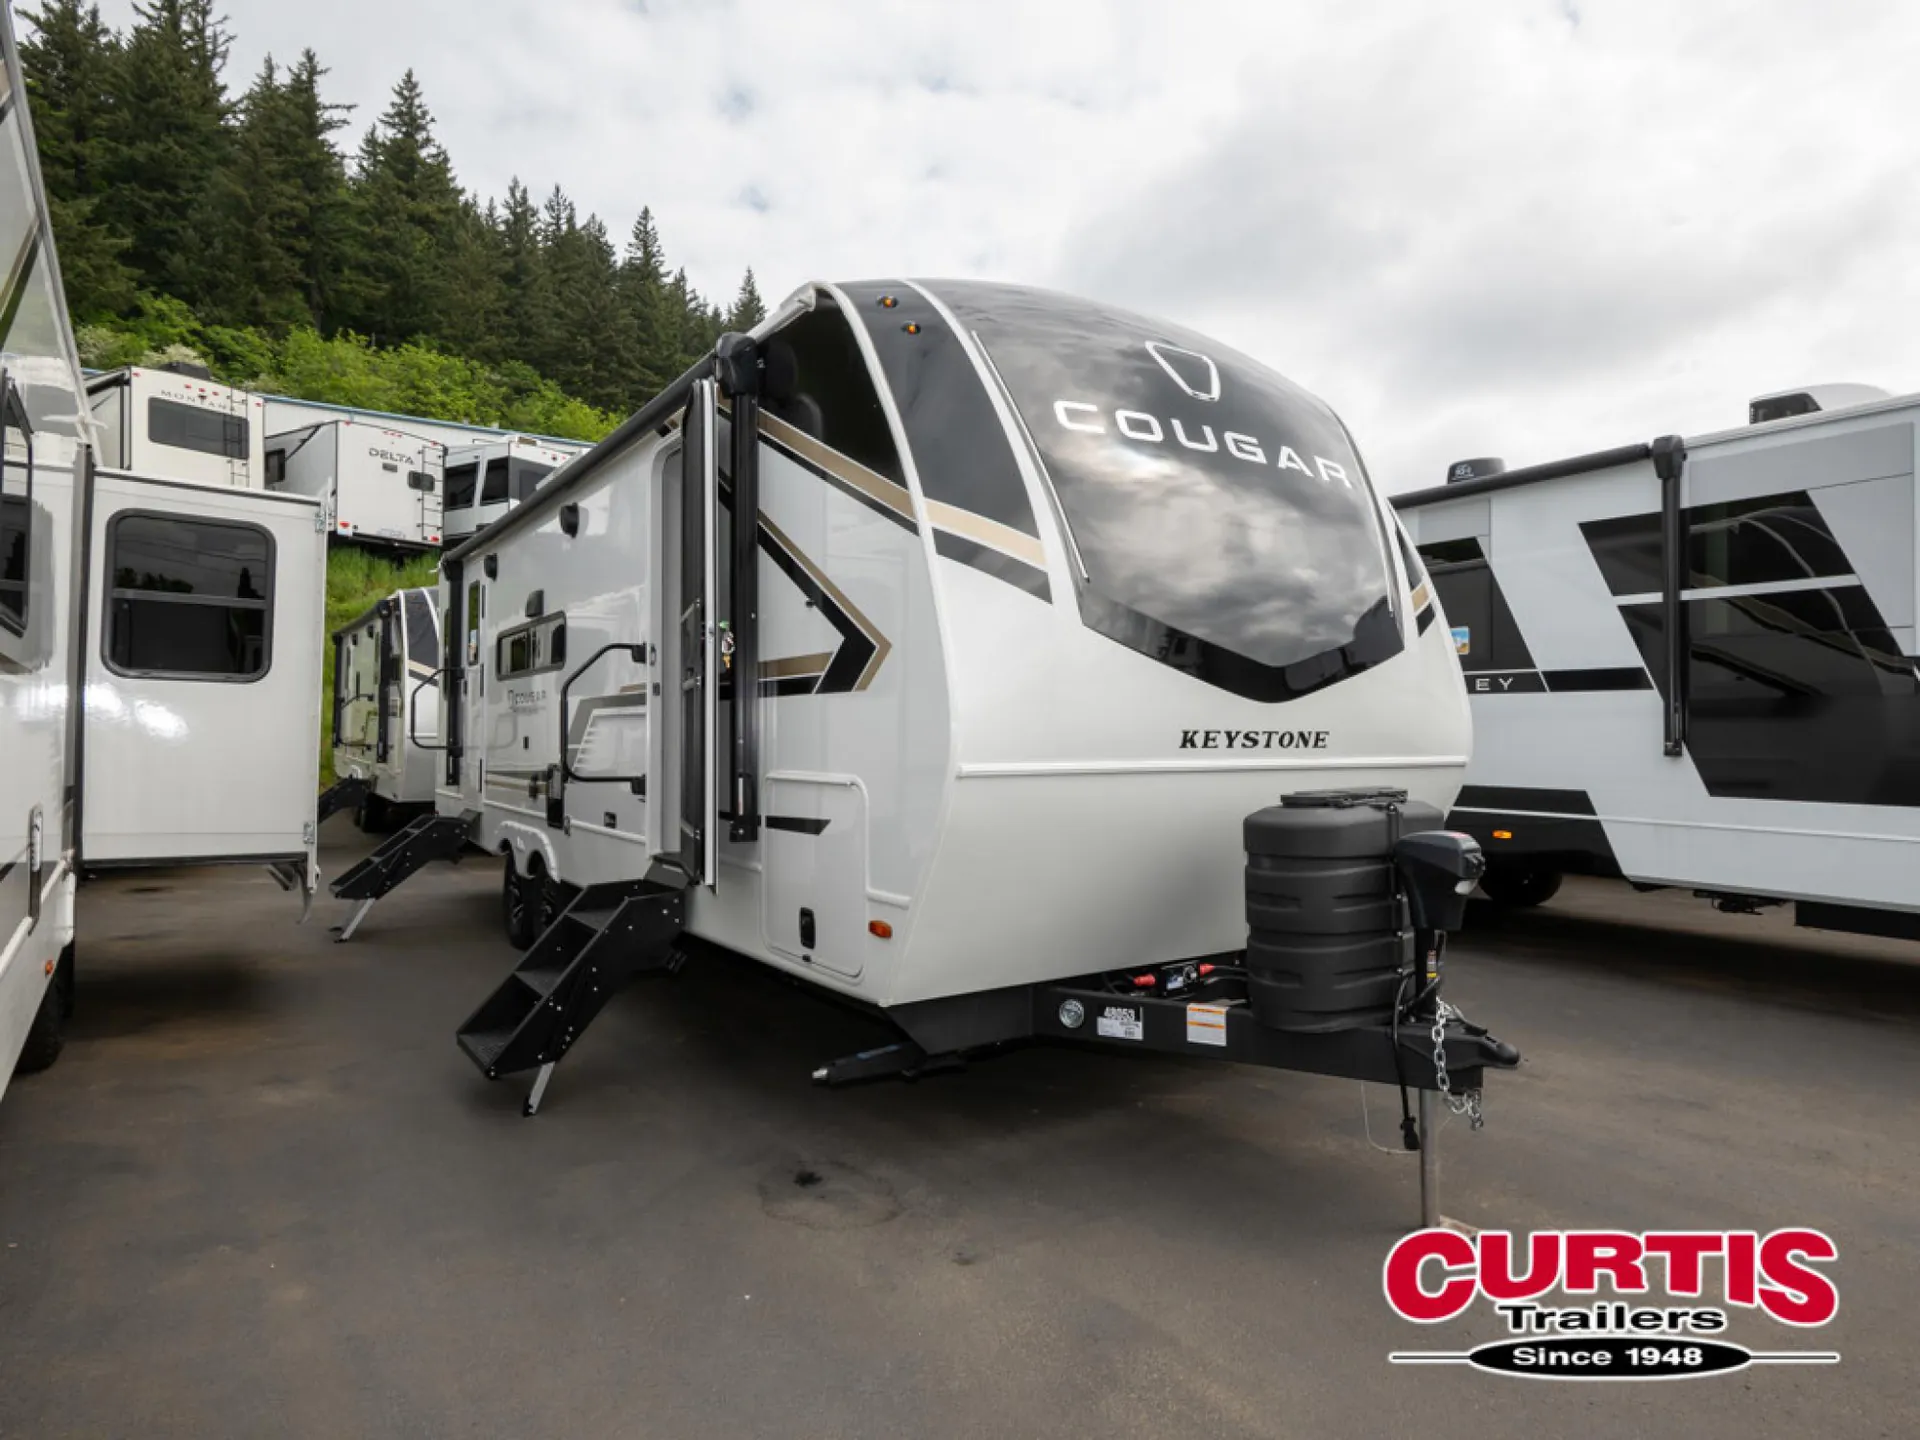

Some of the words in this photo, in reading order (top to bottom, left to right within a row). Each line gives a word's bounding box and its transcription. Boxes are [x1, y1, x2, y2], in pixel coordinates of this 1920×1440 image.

[160, 389, 235, 412] MONTANA
[1053, 400, 1352, 489] COUGAR
[368, 447, 415, 465] DELTA
[1475, 677, 1514, 691] EY
[1179, 729, 1330, 749] KEYSTONE
